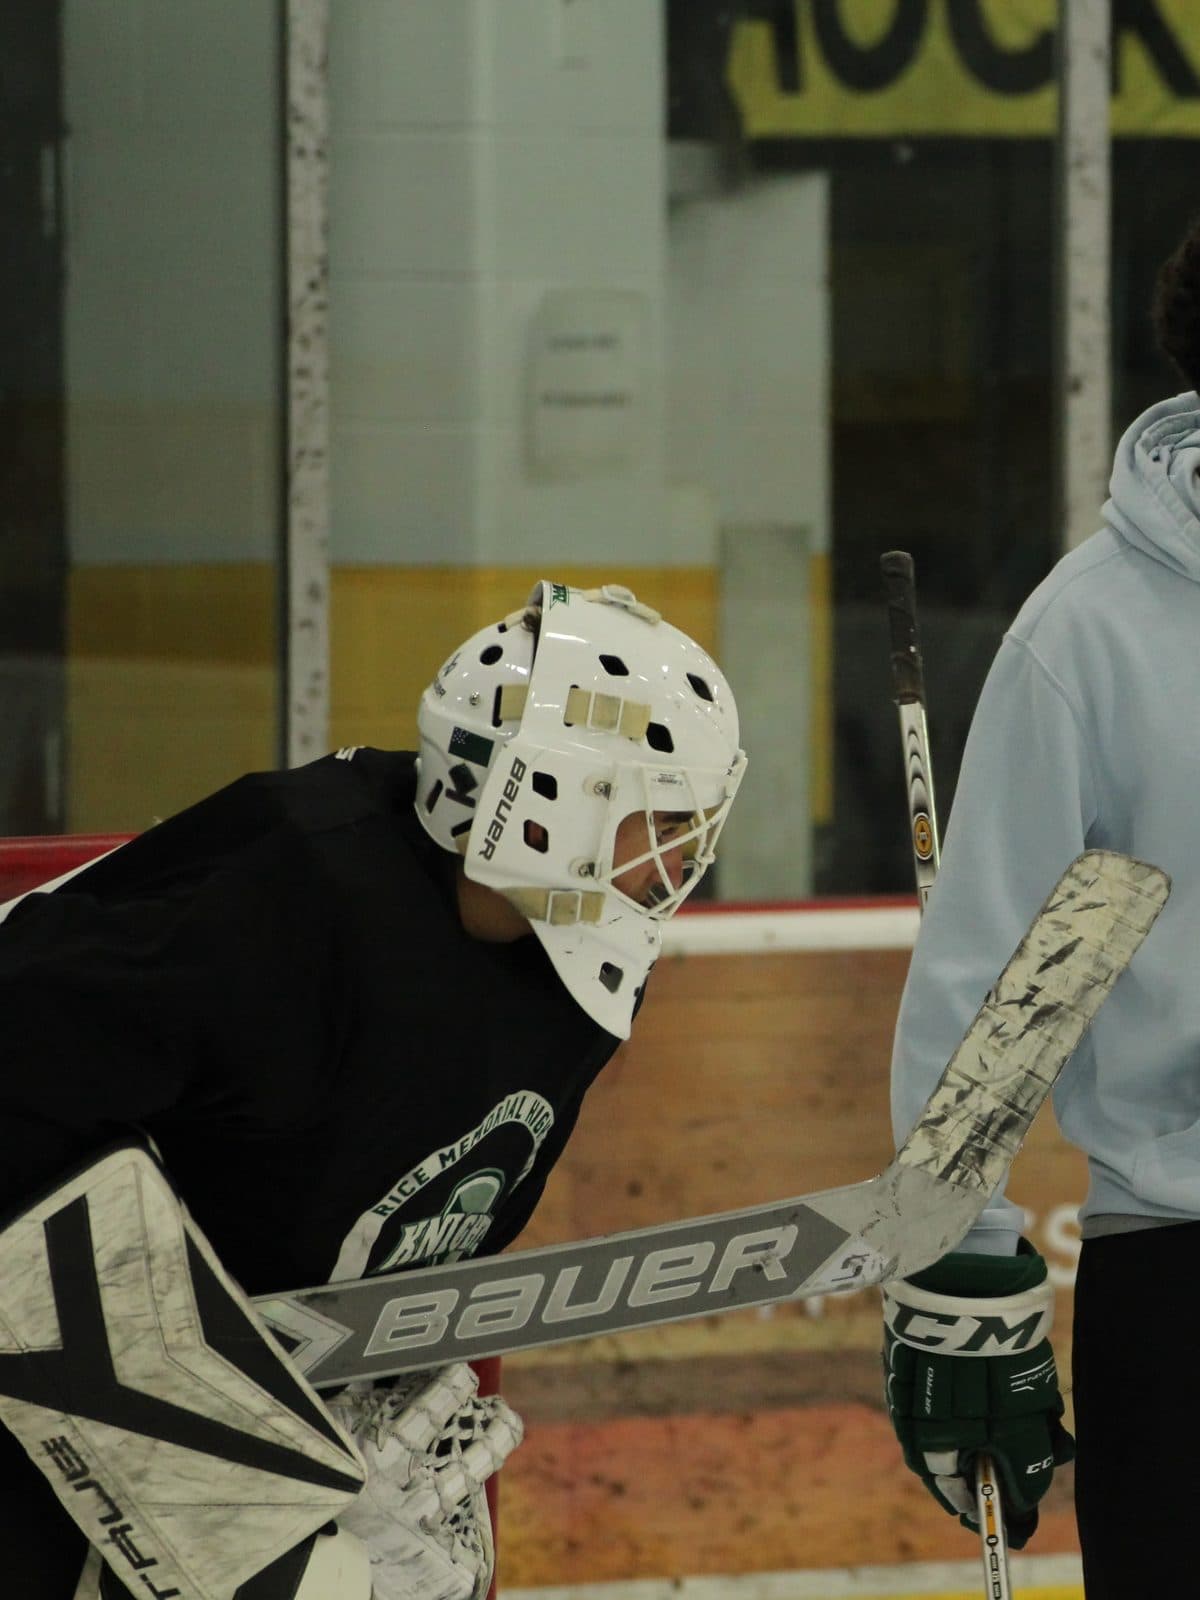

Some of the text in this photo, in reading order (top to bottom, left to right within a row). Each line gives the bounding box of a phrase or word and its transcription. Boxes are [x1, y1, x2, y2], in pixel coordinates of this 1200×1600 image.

[371, 1167, 431, 1217] RICE
[438, 1096, 527, 1170] MEMORIAL
[884, 1298, 1045, 1351] CM
[926, 1366, 934, 1396] PRO
[1026, 1456, 1054, 1474] CC
